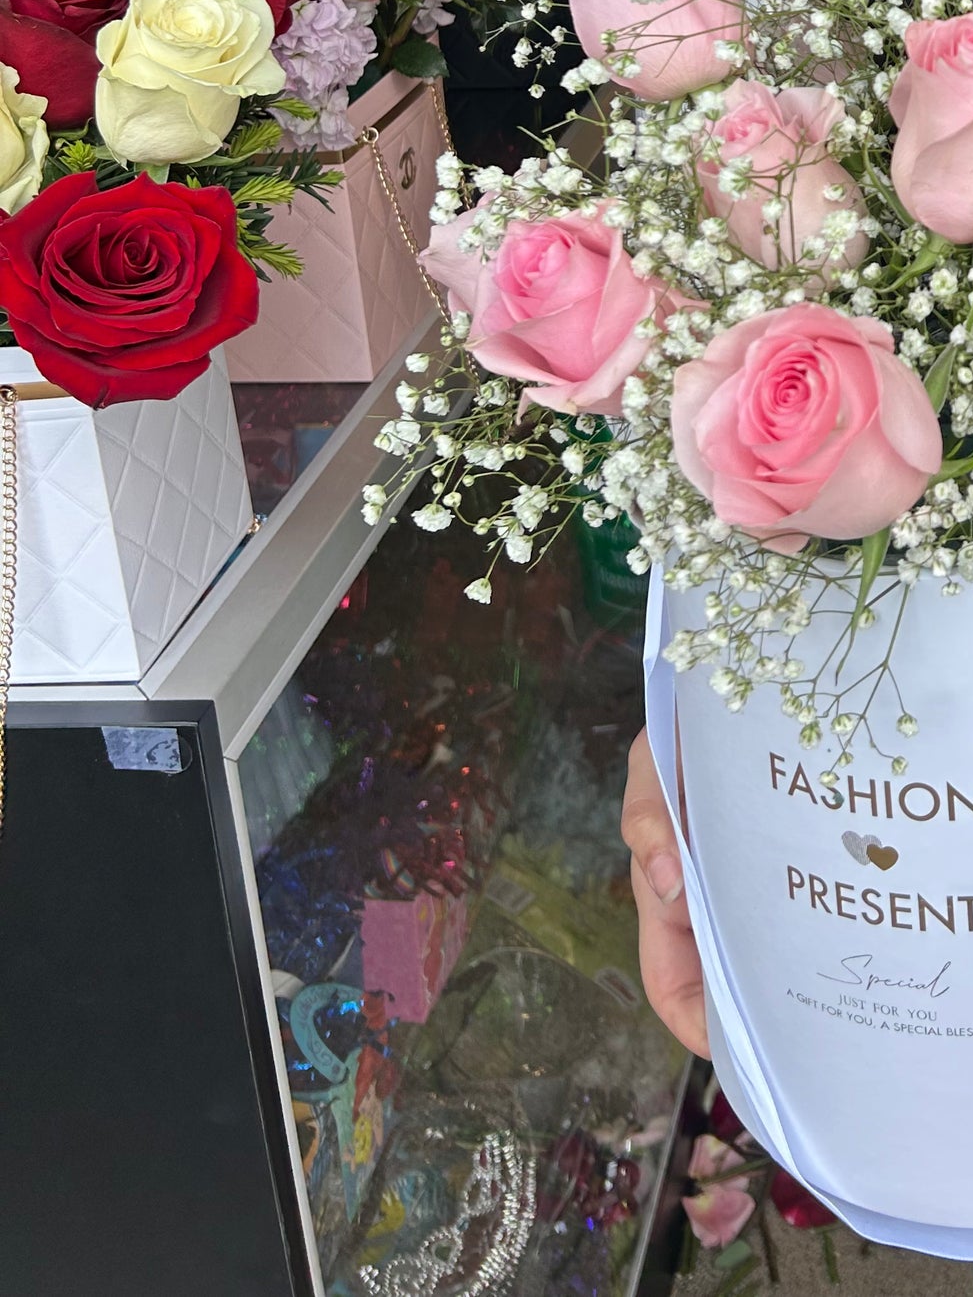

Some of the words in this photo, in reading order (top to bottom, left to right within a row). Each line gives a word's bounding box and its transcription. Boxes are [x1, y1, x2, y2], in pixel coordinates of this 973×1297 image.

[816, 954, 951, 997] Special
[786, 988, 795, 998] A
[796, 992, 818, 1009] GIFT
[821, 1003, 843, 1018] FOR
[846, 1010, 876, 1029] YOU,
[880, 1020, 890, 1030] A
[893, 1022, 942, 1036] SPECIAL
[837, 993, 867, 1010] JUST
[873, 1002, 899, 1016] FOR
[907, 1008, 938, 1021] YOU
